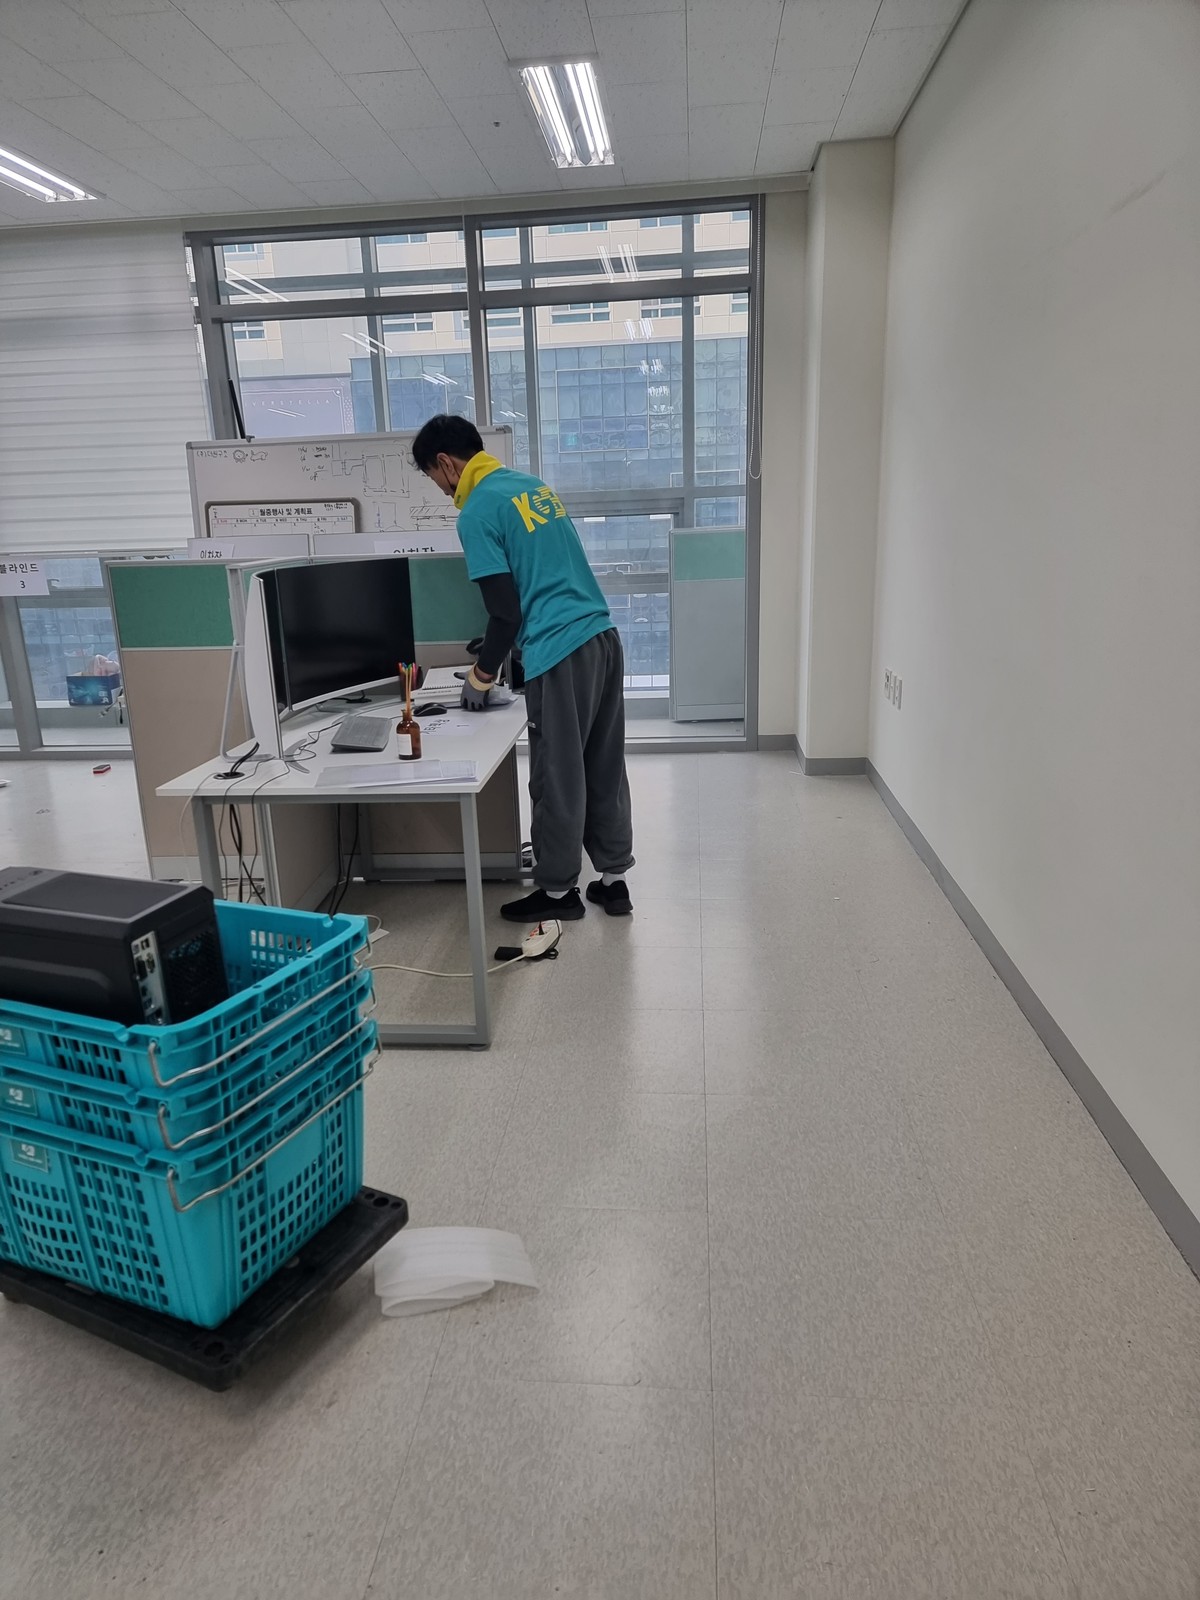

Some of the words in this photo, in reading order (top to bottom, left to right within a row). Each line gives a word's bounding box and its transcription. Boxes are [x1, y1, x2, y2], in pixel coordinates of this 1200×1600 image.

[260, 508, 284, 517] 월중행사
[286, 508, 292, 516] 및
[294, 507, 313, 516] 계획표
[0, 562, 40, 575] 블라인드
[19, 580, 26, 589] 3
